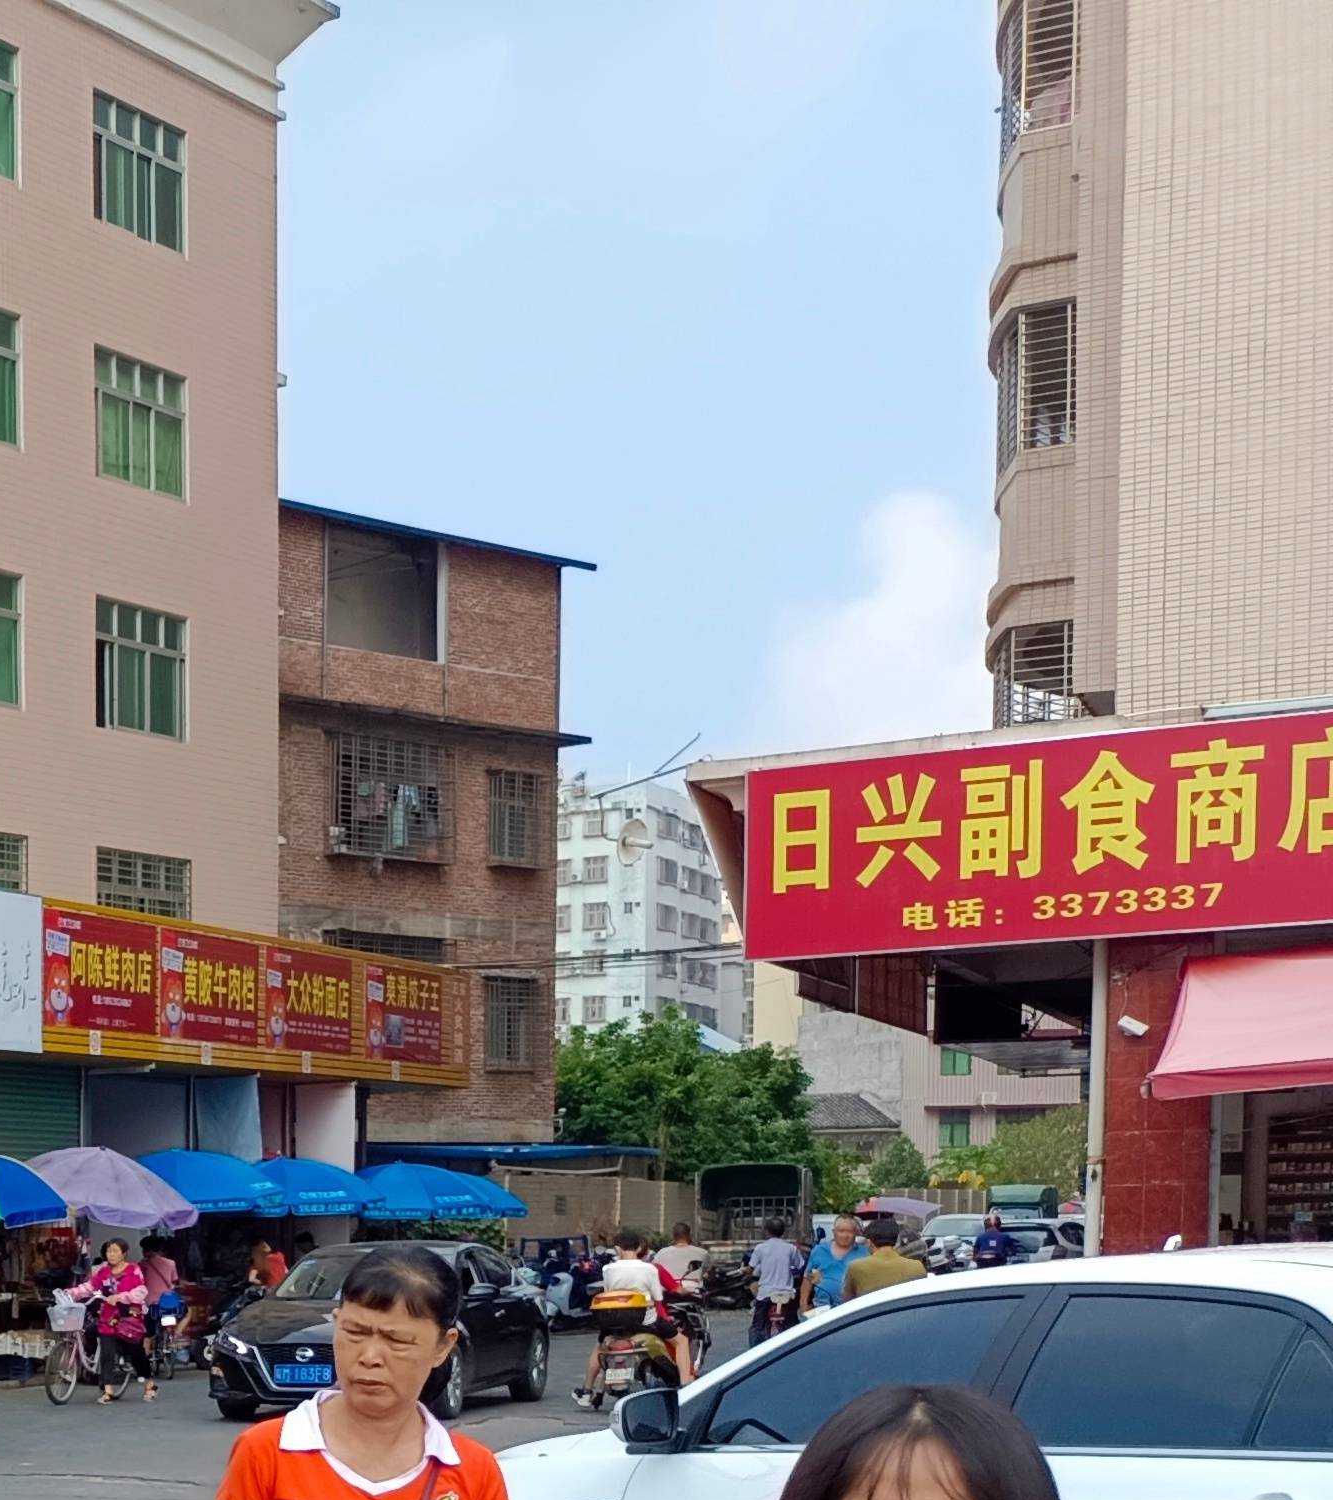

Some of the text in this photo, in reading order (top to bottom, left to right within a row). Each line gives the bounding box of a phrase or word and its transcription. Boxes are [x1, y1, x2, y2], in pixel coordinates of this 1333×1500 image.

[773, 728, 1333, 894] 日兴副食商店
[1032, 882, 1224, 920] 3373337
[70, 941, 152, 995] 阿陈鲜肉店
[286, 970, 350, 1019] 大众粉面店
